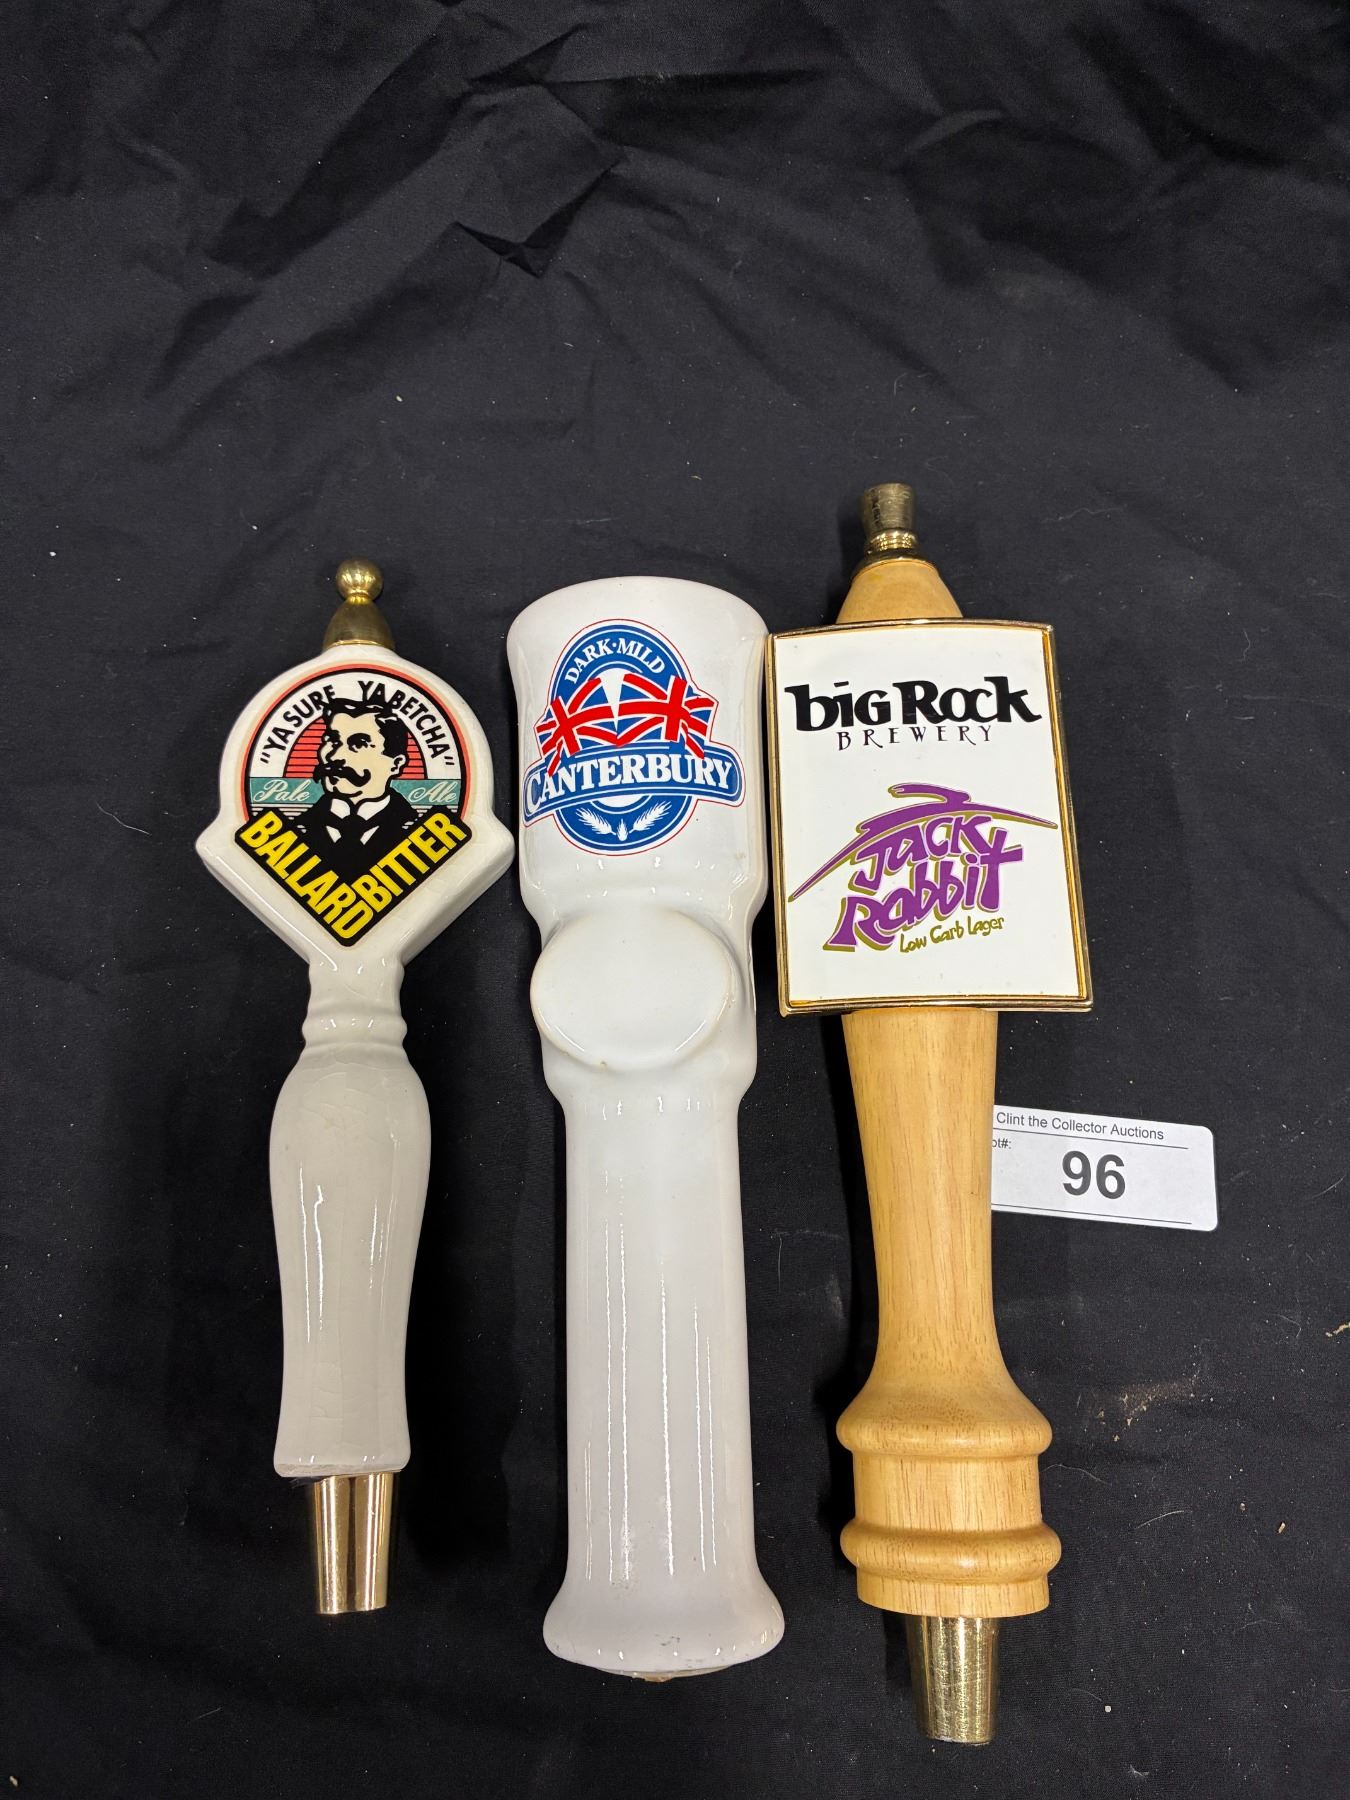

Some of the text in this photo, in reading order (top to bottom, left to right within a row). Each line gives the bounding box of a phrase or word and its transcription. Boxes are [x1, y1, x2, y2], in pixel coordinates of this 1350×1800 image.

[837, 725, 992, 751] BREWERY
[253, 779, 458, 803] Pale Ale
[526, 753, 733, 814] CANTERBURY
[239, 810, 467, 939] BALLARD BITTER
[900, 915, 1005, 953] Low Carb Lager
[996, 1111, 1165, 1140] Clint the Collector Auctions
[1062, 1150, 1126, 1200] 96
